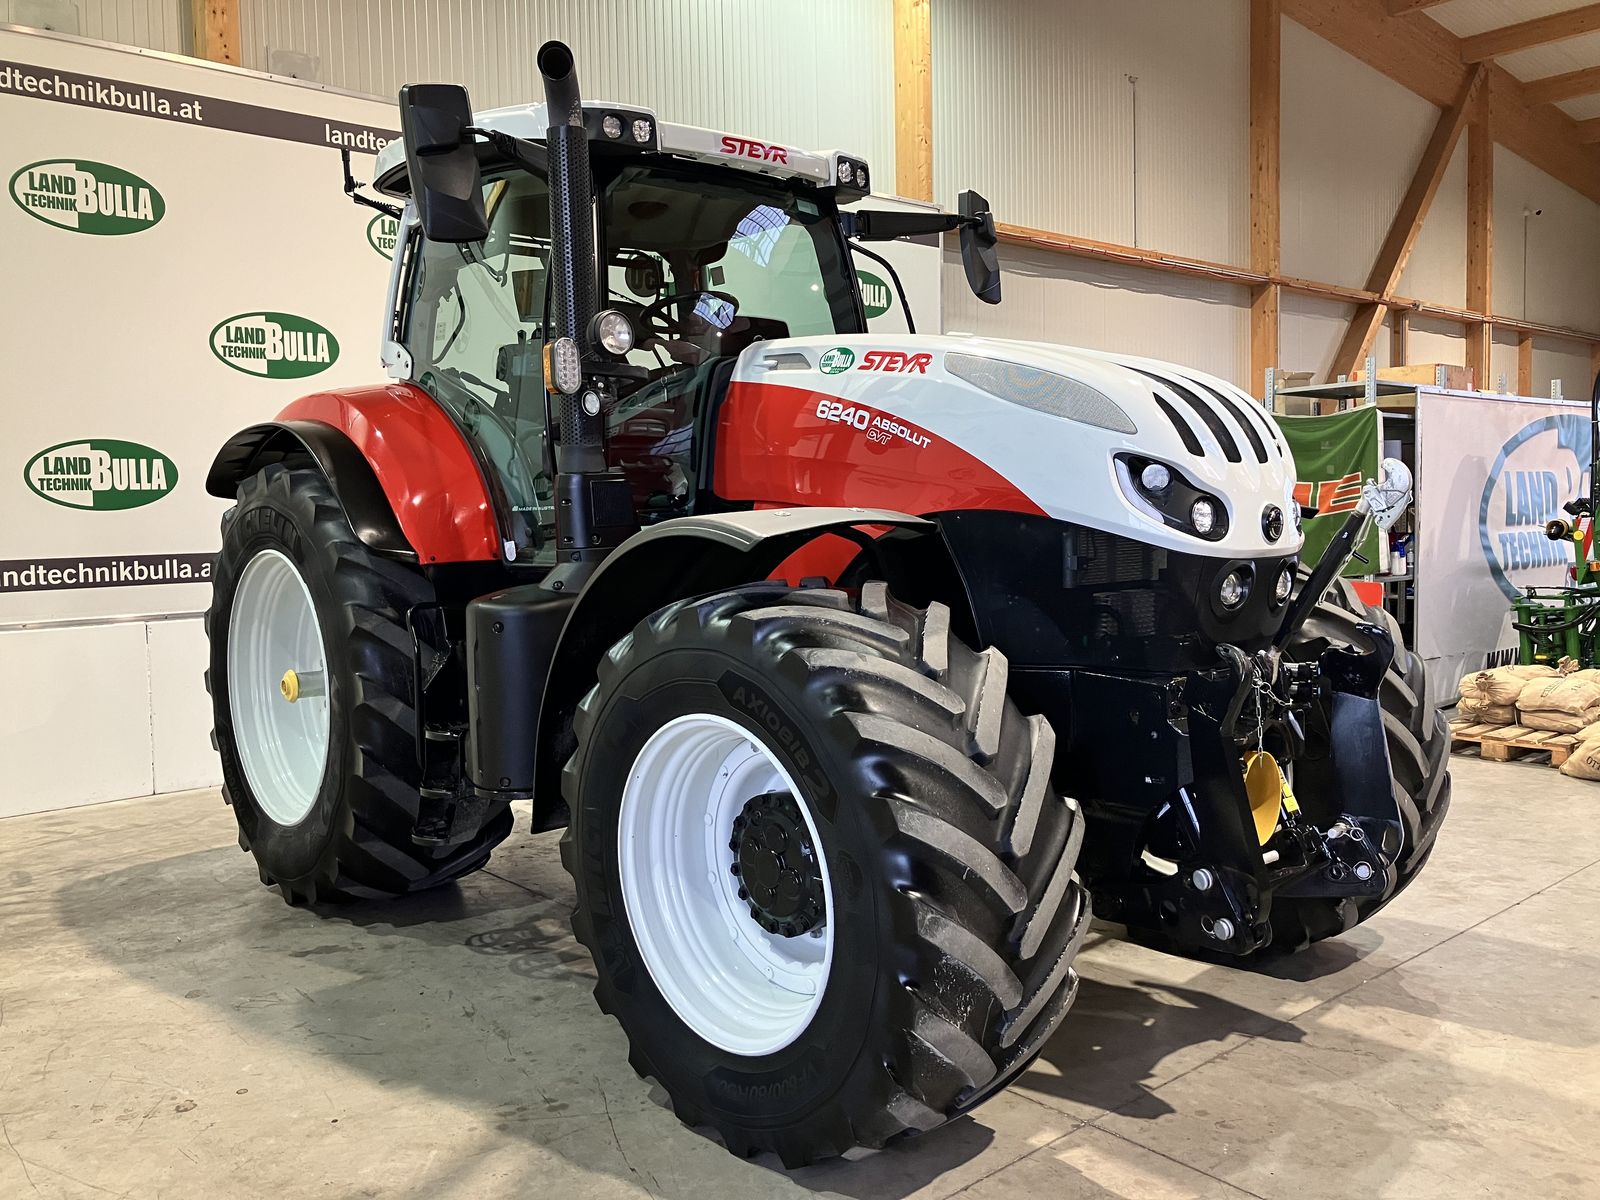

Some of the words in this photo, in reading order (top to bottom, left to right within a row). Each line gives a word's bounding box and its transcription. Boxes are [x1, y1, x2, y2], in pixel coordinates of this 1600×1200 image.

[0, 67, 203, 121] dtechnikbulla.at
[720, 136, 788, 165] STEYR
[28, 170, 77, 196] LAND
[76, 169, 154, 222] BULLA
[23, 192, 78, 212] TECHNIK
[377, 236, 396, 249] TEC
[225, 324, 266, 345] LAND
[265, 321, 331, 363] BULLA
[221, 345, 267, 360] TECHNIK
[857, 350, 933, 375] STEYR
[816, 399, 870, 432] 6240
[871, 416, 931, 449] ABSOLUT
[43, 456, 91, 476] LAND
[90, 449, 168, 492] BULLA
[37, 477, 93, 492] TECHNIK
[1503, 470, 1558, 527] LAND
[0, 559, 211, 587] ndtechnikbulla.a
